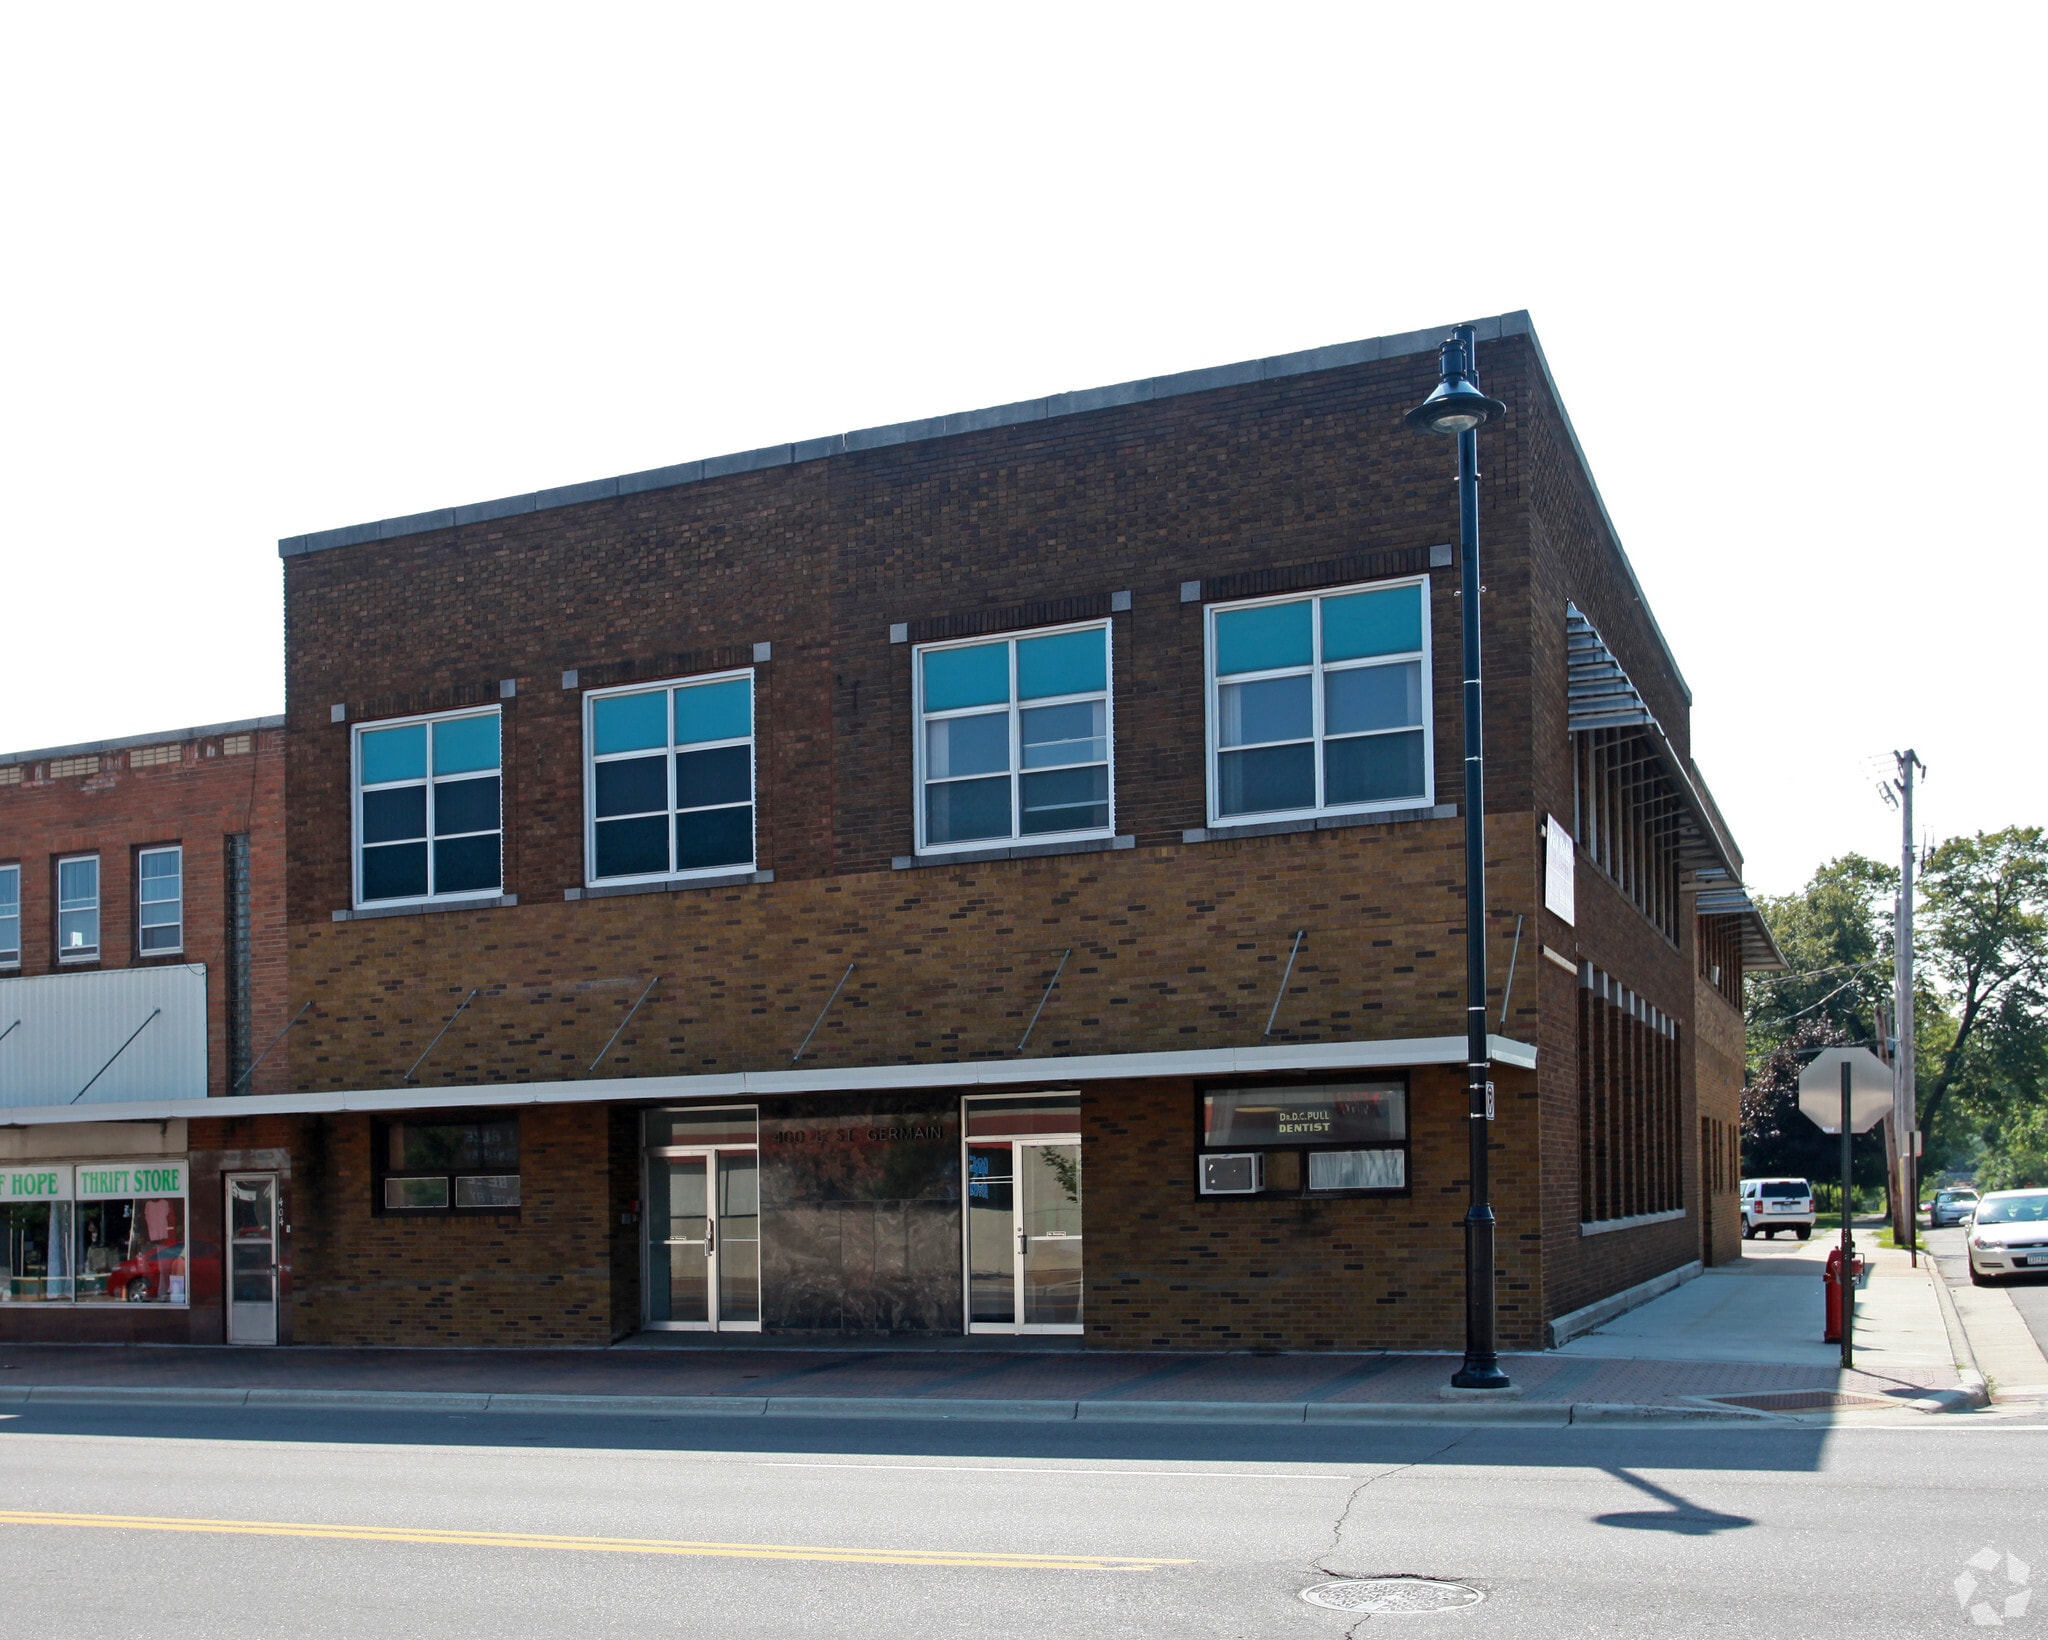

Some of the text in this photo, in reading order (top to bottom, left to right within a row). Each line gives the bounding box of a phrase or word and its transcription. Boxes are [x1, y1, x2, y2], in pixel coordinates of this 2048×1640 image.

[773, 1130, 805, 1144] 400
[867, 1126, 942, 1142] GERMAIN
[1279, 1122, 1331, 1133] DENTIST
[11, 1172, 58, 1195] HOPE
[81, 1168, 180, 1194] THRIFT STORE
